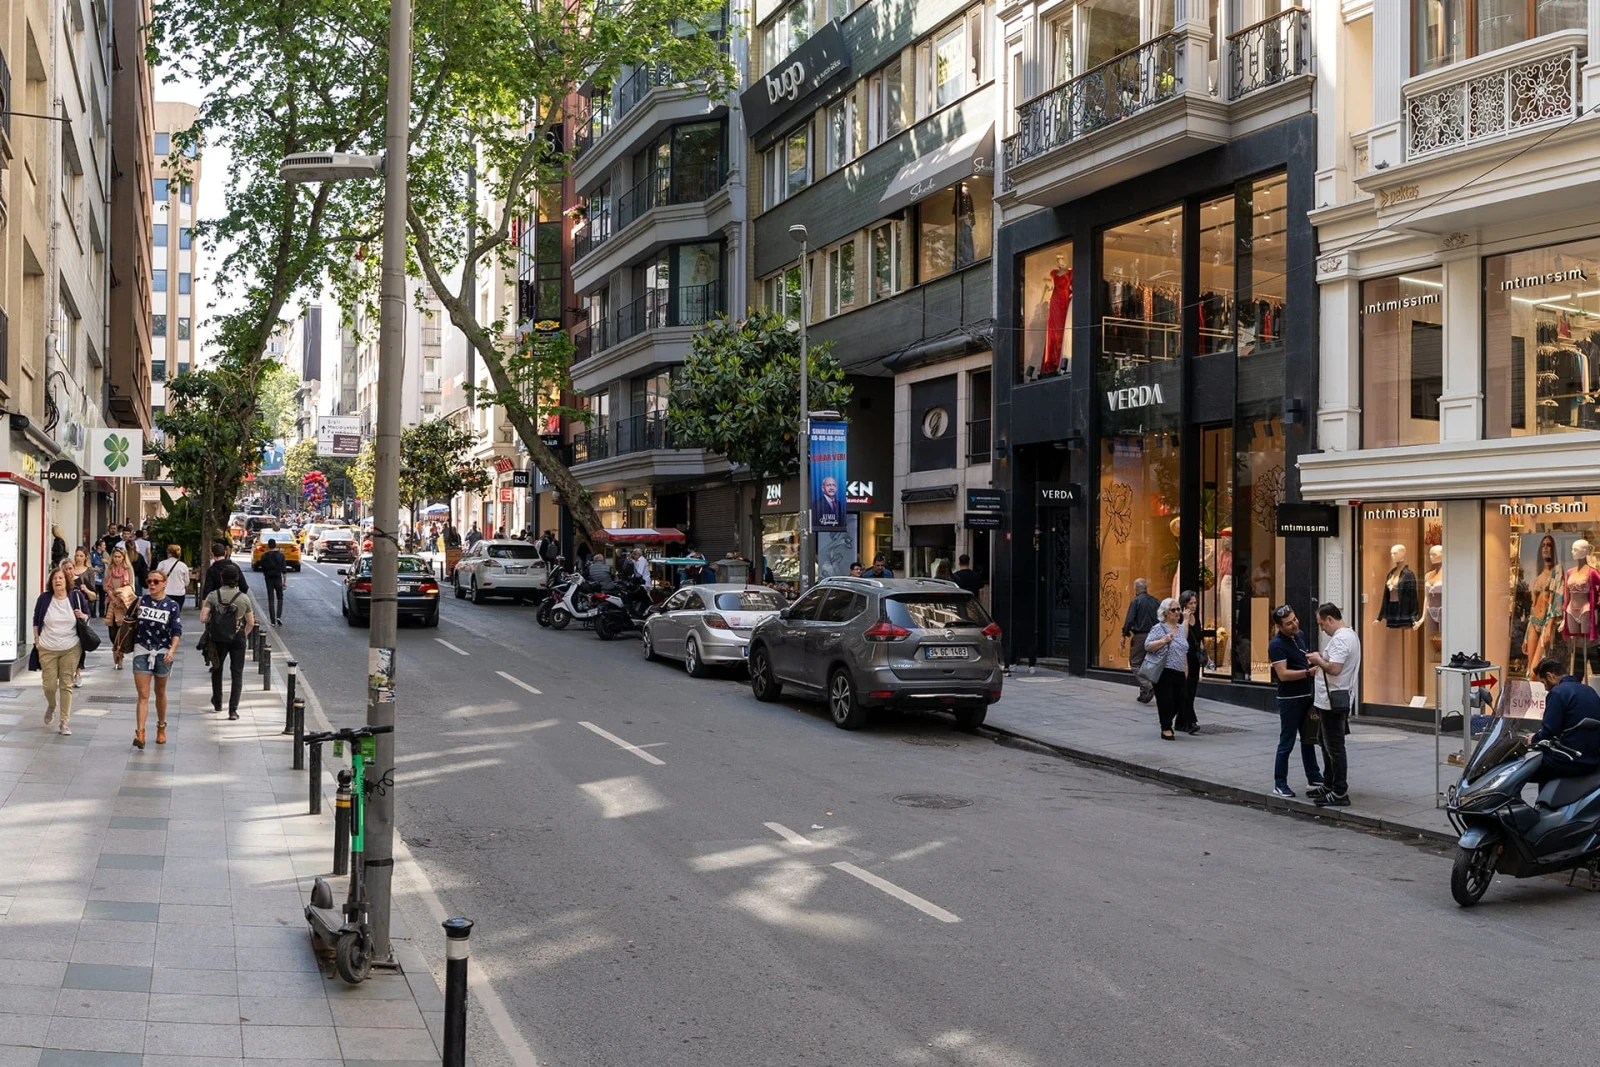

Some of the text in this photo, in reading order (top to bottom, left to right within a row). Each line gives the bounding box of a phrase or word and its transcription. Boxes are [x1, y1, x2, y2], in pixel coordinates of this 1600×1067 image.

[765, 61, 805, 105] bugo
[1365, 293, 1440, 314] intimissimi
[1107, 383, 1164, 411] VERDA
[49, 472, 78, 480] PIANO
[514, 475, 528, 484] BSL
[766, 483, 781, 499] ZEN
[1042, 489, 1074, 499] VERDA
[1364, 507, 1439, 519] intimissimi
[1499, 502, 1588, 515] intimissimi
[1281, 523, 1329, 532] intimissimi
[929, 648, 938, 656] 34
[1512, 699, 1545, 709] SUMME
